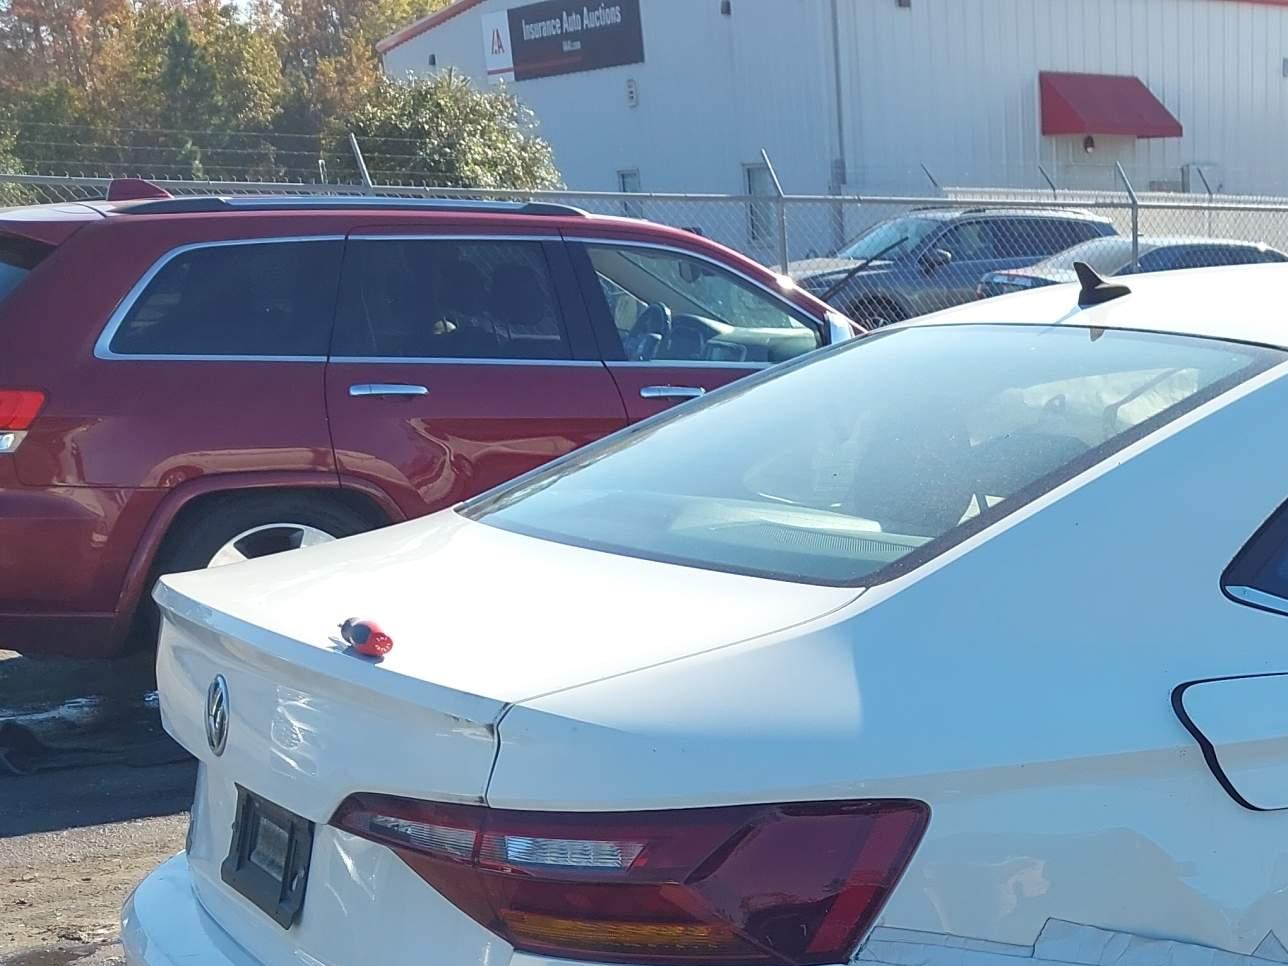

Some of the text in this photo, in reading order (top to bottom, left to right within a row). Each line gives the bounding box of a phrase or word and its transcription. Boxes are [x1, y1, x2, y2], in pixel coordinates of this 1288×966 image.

[522, 3, 621, 41] Insurance Auto Auctions
